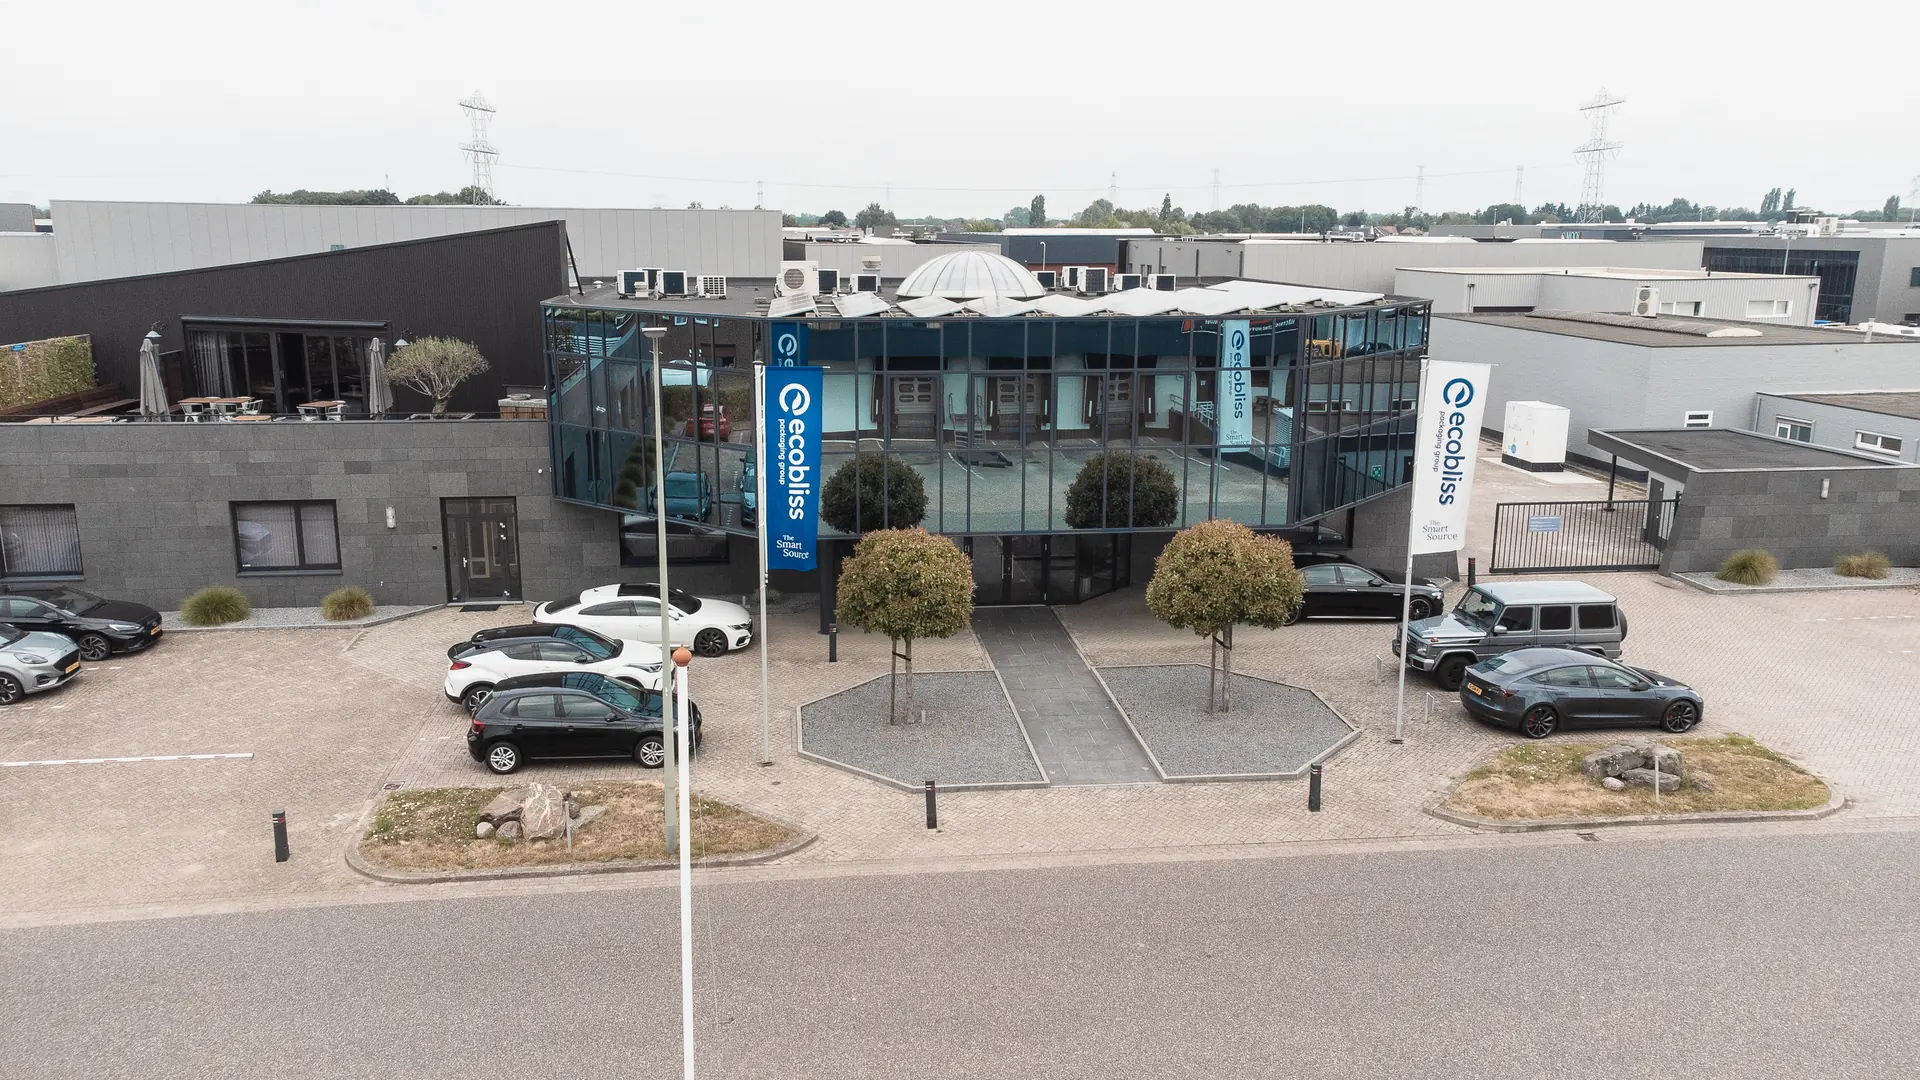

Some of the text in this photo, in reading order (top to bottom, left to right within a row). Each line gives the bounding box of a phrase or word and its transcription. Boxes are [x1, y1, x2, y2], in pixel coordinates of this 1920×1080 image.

[1233, 352, 1246, 419] ecobliss
[778, 418, 787, 485] packaging group
[788, 418, 811, 520] ecobliss
[1432, 410, 1446, 472] packaging group
[1438, 411, 1466, 505] ecobliss
[776, 539, 802, 550] Smart
[782, 548, 809, 560] Source
[1422, 525, 1448, 533] Smart
[1426, 533, 1458, 541] Source
